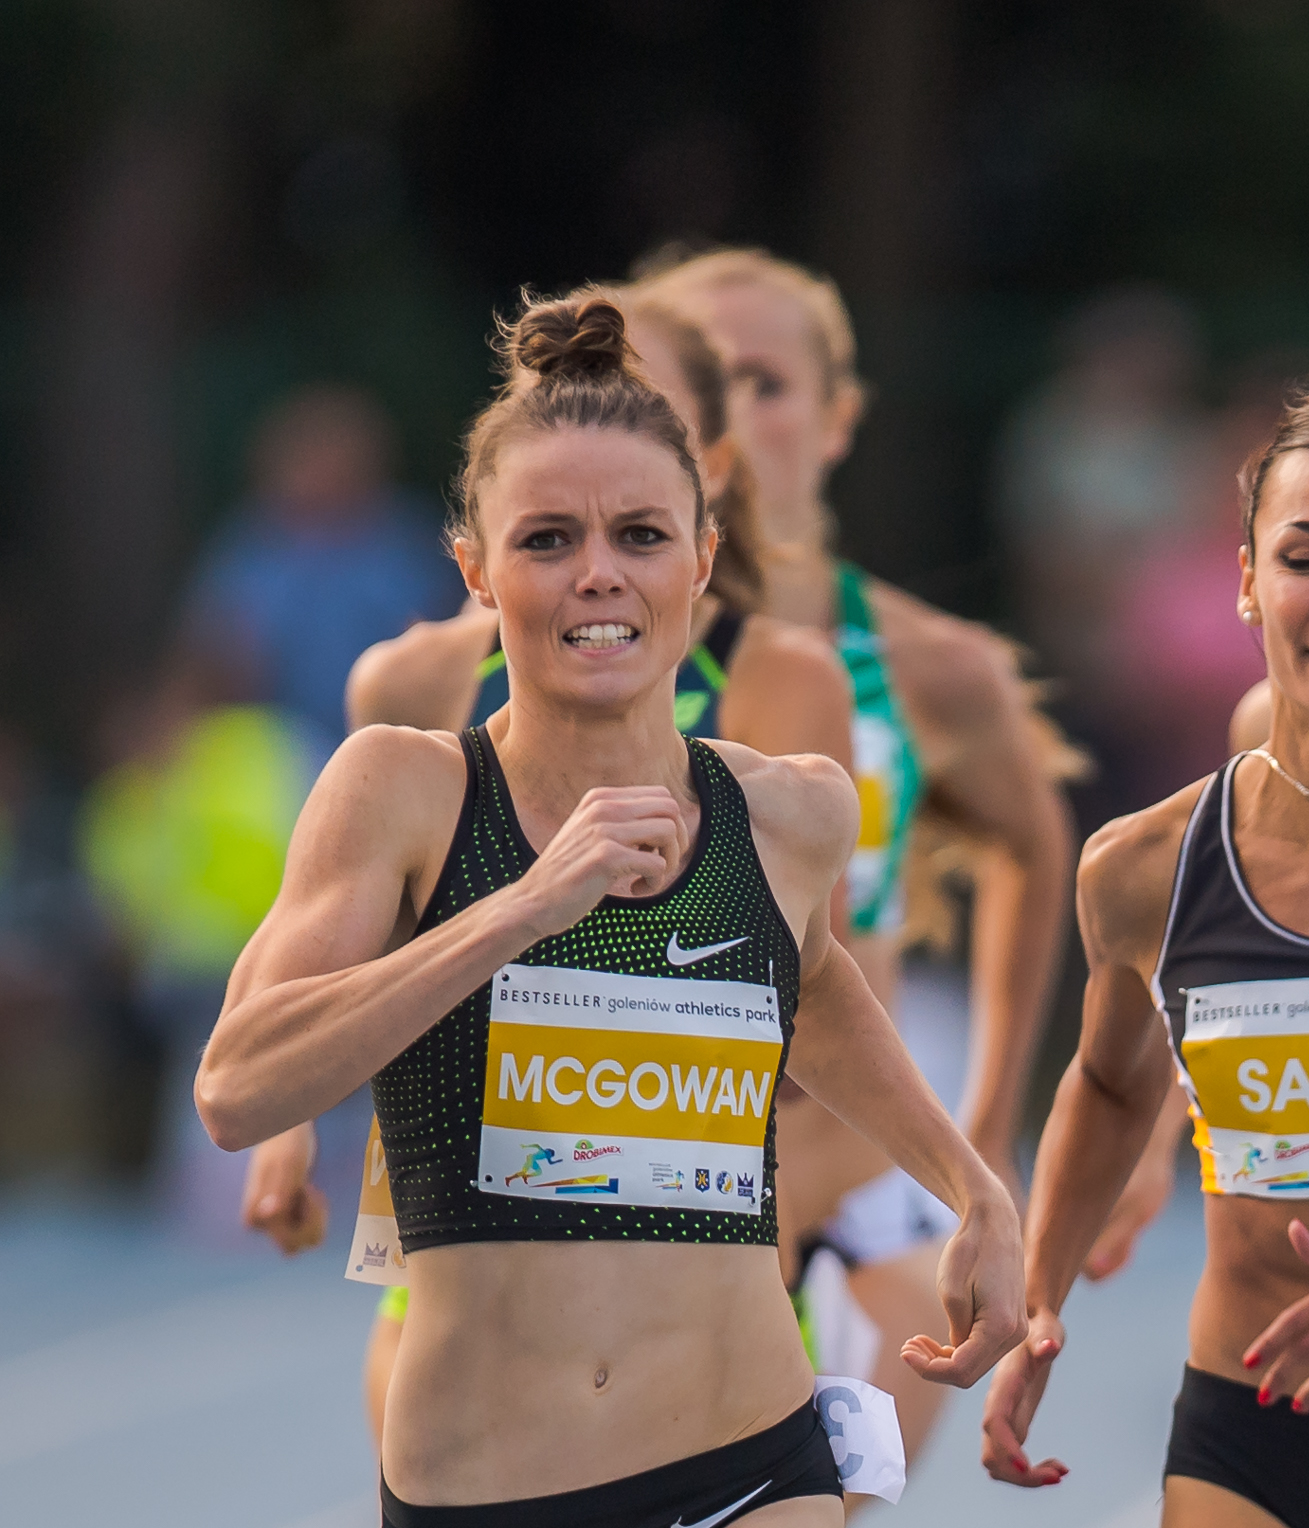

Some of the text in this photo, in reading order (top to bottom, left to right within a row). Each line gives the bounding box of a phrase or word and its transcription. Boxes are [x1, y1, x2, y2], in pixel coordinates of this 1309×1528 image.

[500, 989, 776, 1023] BESTSELLER goleniów athletics park
[1193, 1002, 1281, 1023] BESTSELLER
[498, 1052, 771, 1118] MCGOWAN
